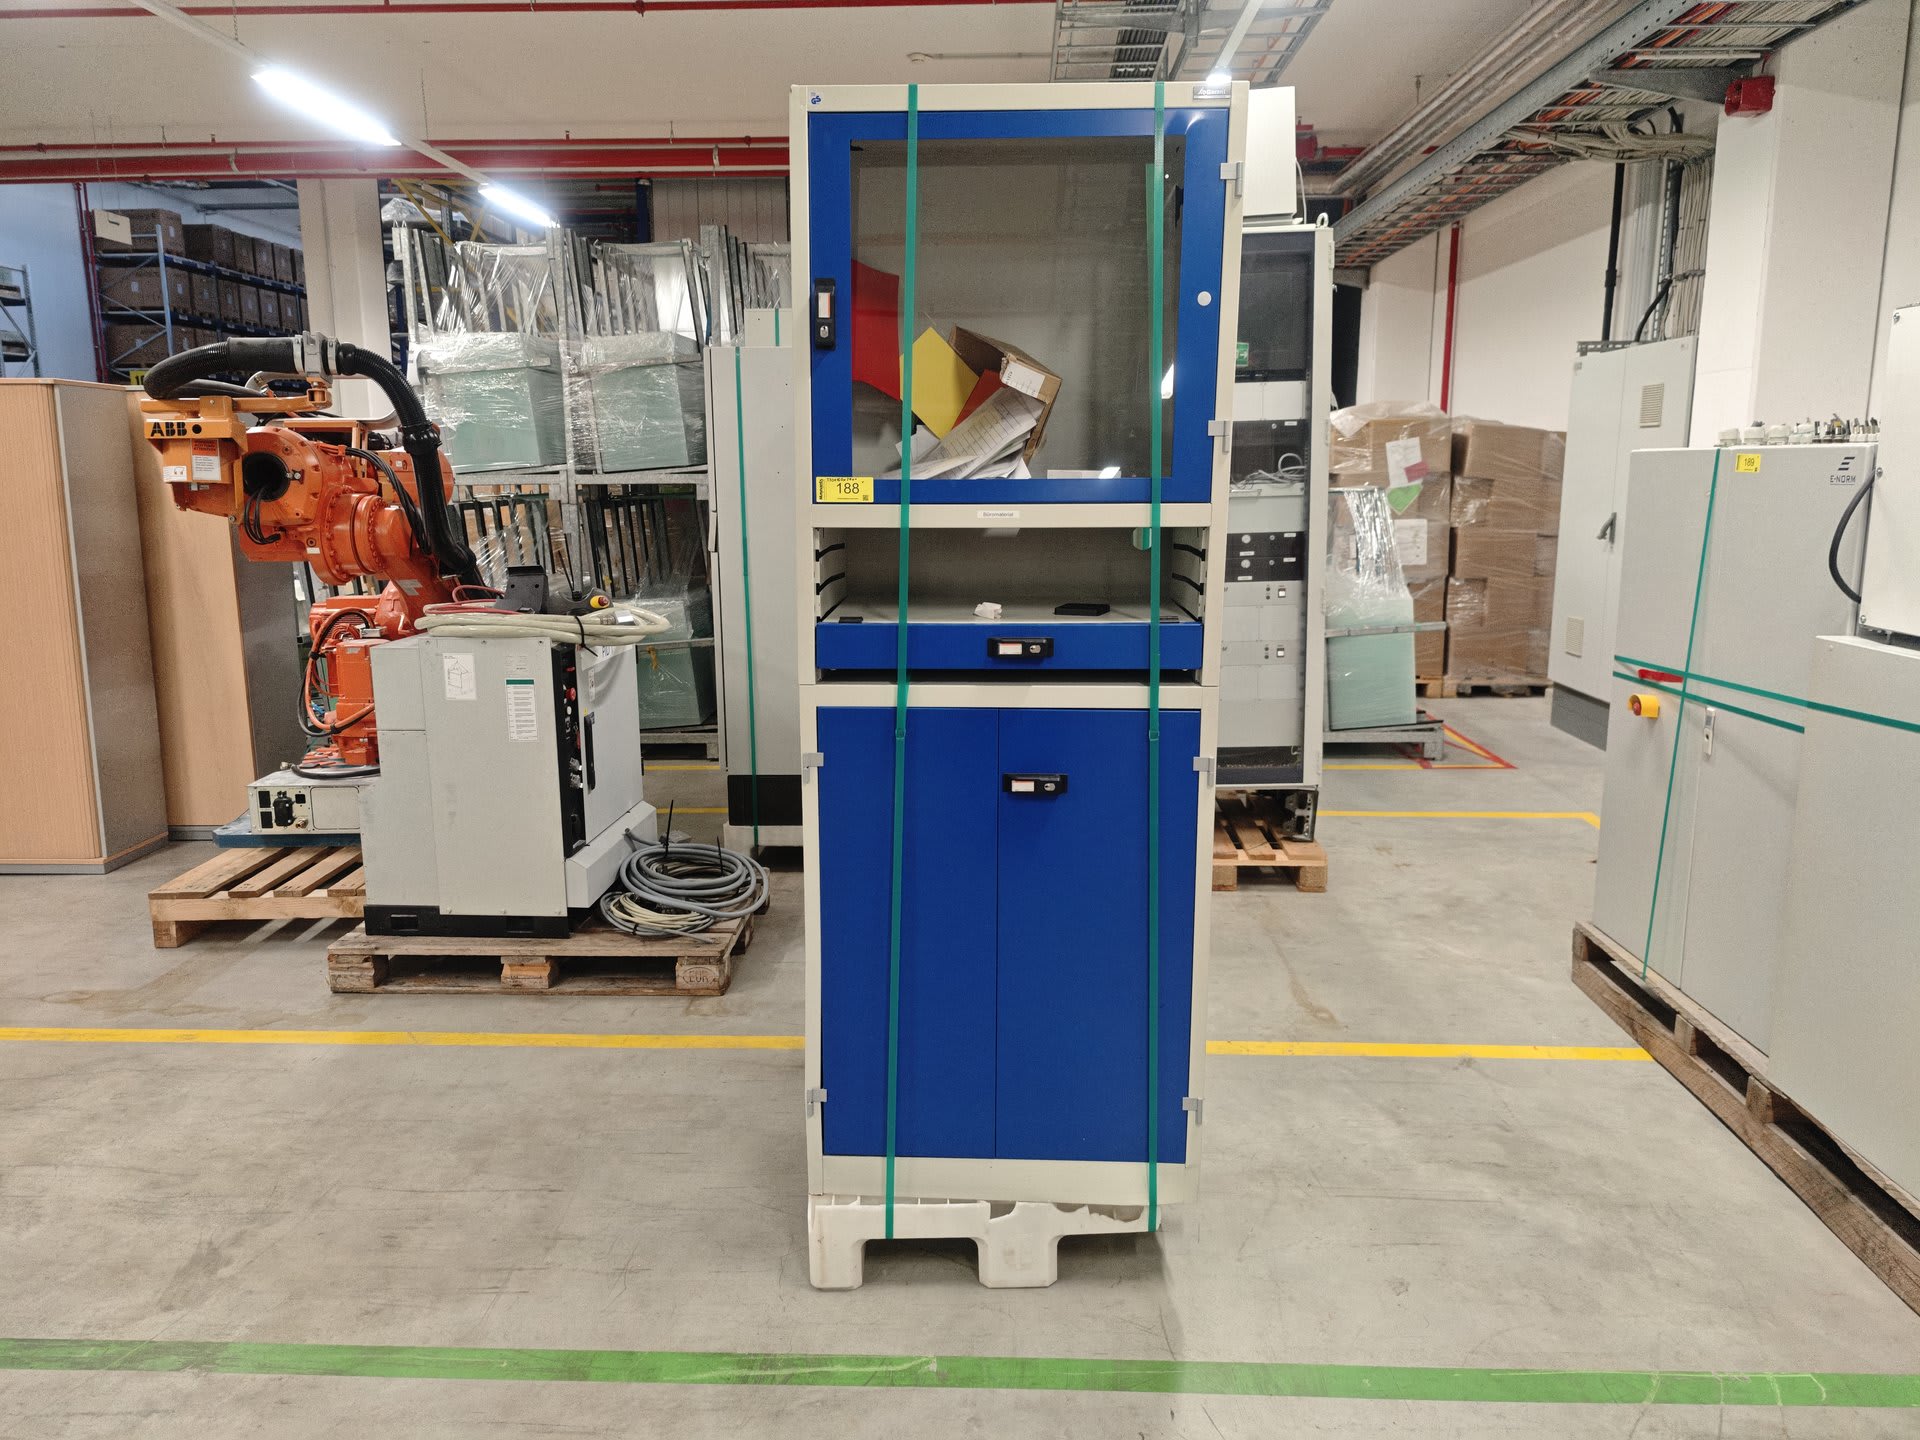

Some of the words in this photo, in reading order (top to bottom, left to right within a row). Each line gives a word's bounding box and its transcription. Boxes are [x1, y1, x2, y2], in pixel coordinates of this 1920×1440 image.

[151, 422, 187, 437] ABB
[1744, 458, 1755, 467] 189
[1830, 474, 1856, 483] E-NORM
[837, 482, 860, 495] 188
